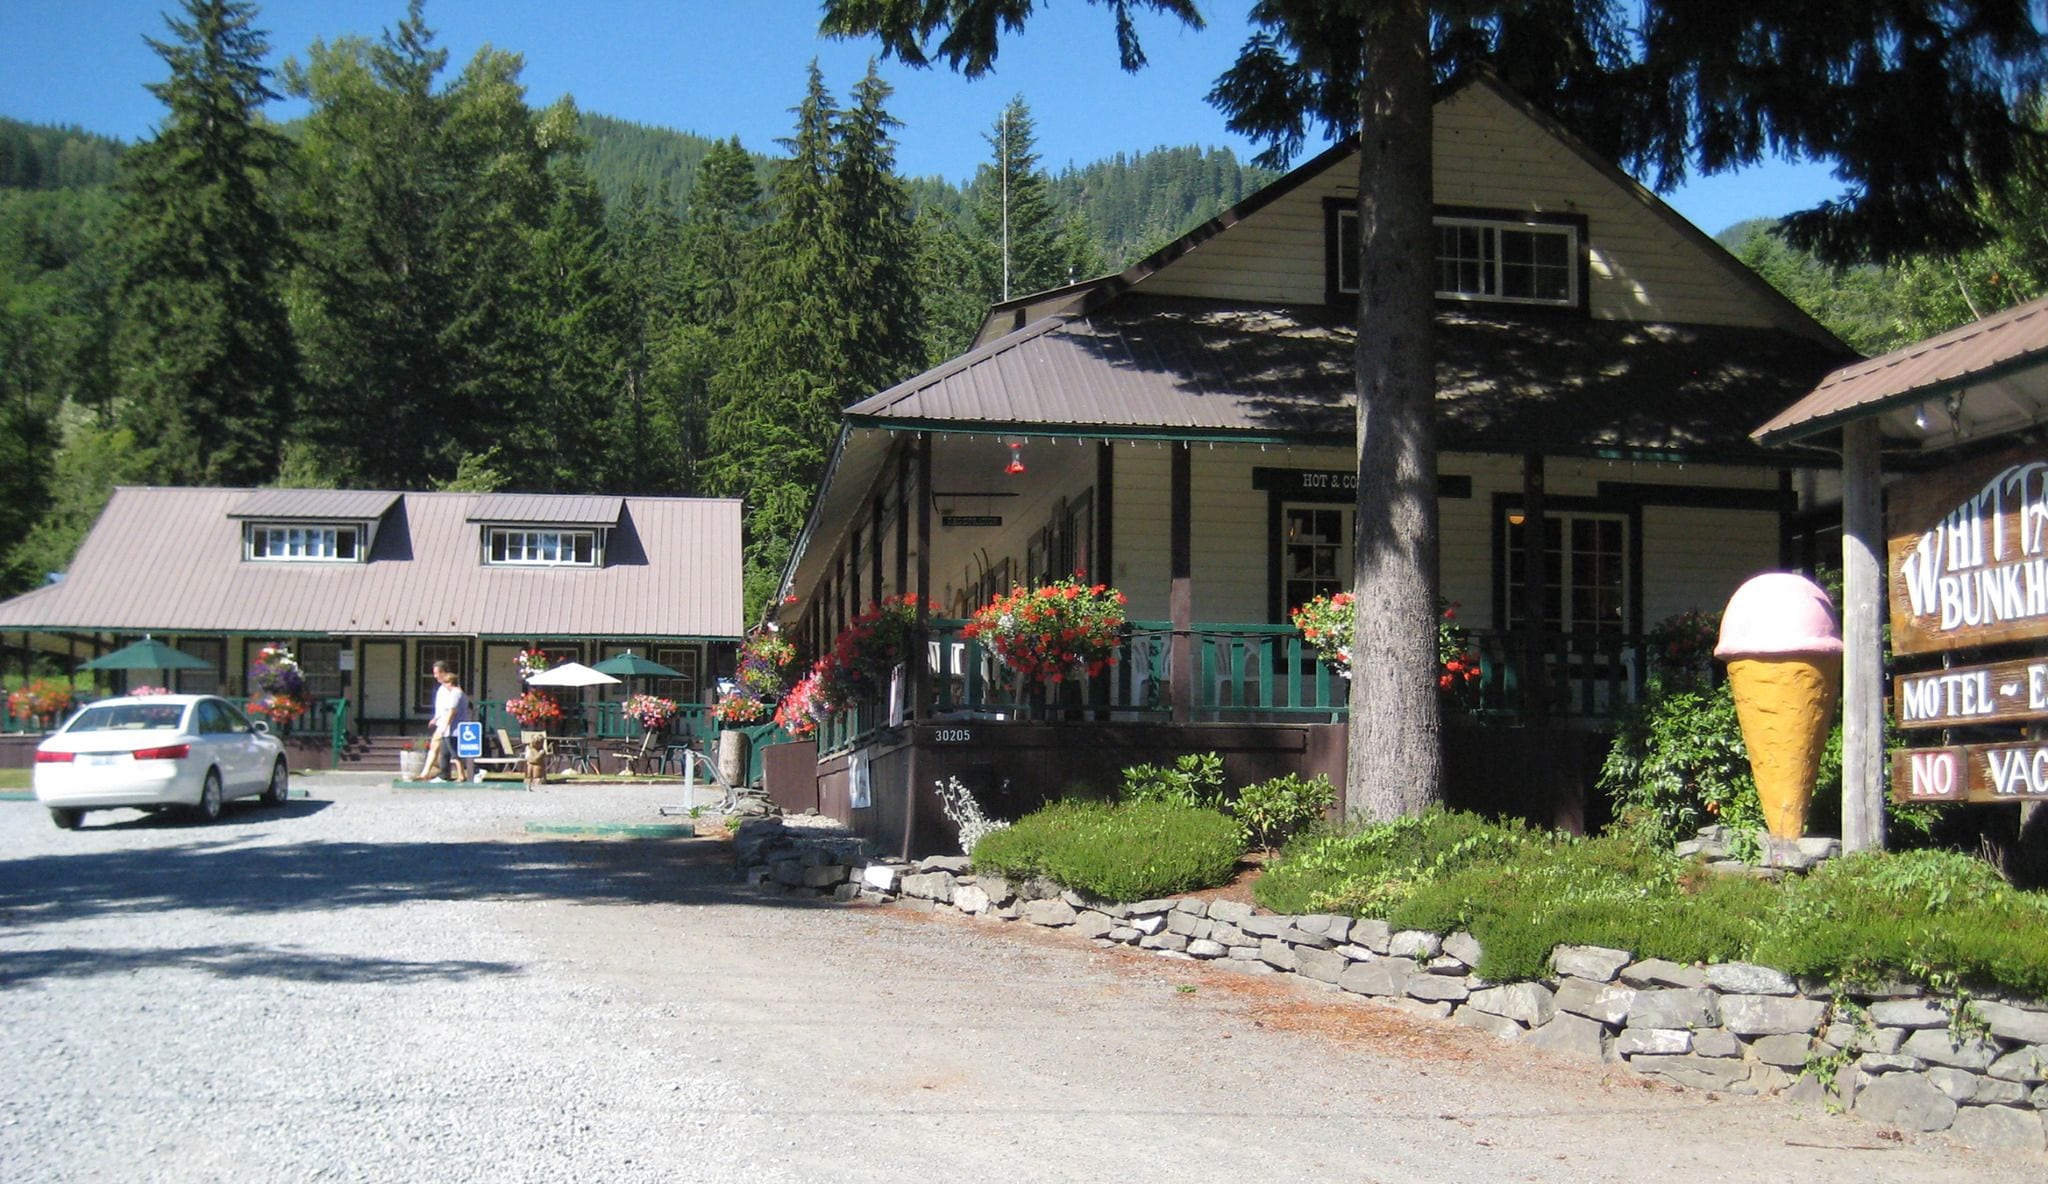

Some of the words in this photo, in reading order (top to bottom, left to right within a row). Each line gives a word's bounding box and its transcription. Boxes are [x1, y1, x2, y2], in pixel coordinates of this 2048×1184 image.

[1303, 473, 1328, 488] HOT
[1331, 474, 1340, 488] &
[1938, 558, 2048, 631] BUNKH
[1902, 670, 1993, 720] MOTEL
[935, 729, 970, 742] 30205
[1911, 752, 1953, 795] NO
